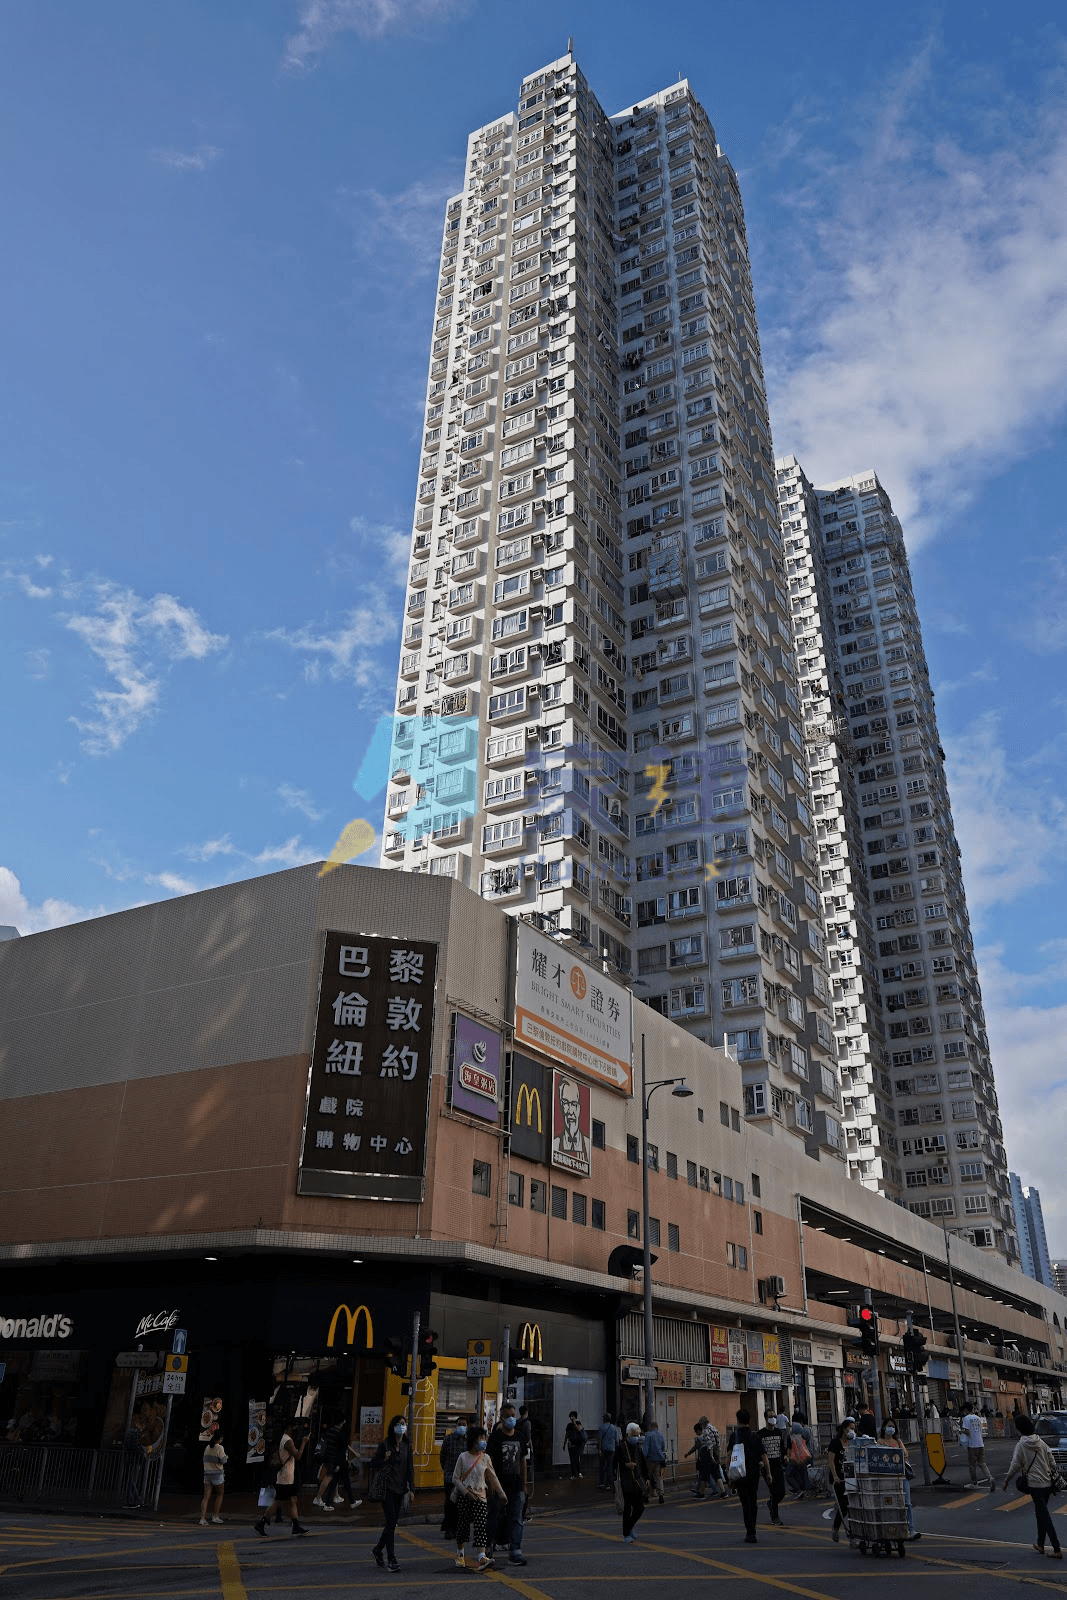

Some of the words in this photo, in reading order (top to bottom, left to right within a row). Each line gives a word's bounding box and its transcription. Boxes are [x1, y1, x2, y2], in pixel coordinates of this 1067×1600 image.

[337, 944, 425, 985] 巴黎
[531, 948, 567, 989] 耀才
[331, 990, 424, 1033] 倫敦
[530, 980, 559, 1005] BRIGHT
[560, 998, 584, 1019] SMART
[586, 1013, 621, 1039] SECURITIES
[590, 984, 620, 1022] 證券
[324, 1038, 419, 1081] 紐約
[318, 1096, 364, 1117] 戲院
[315, 1129, 413, 1155] 購物中心
[167, 1382, 181, 1392] 全日
[471, 1366, 485, 1375] 全日
